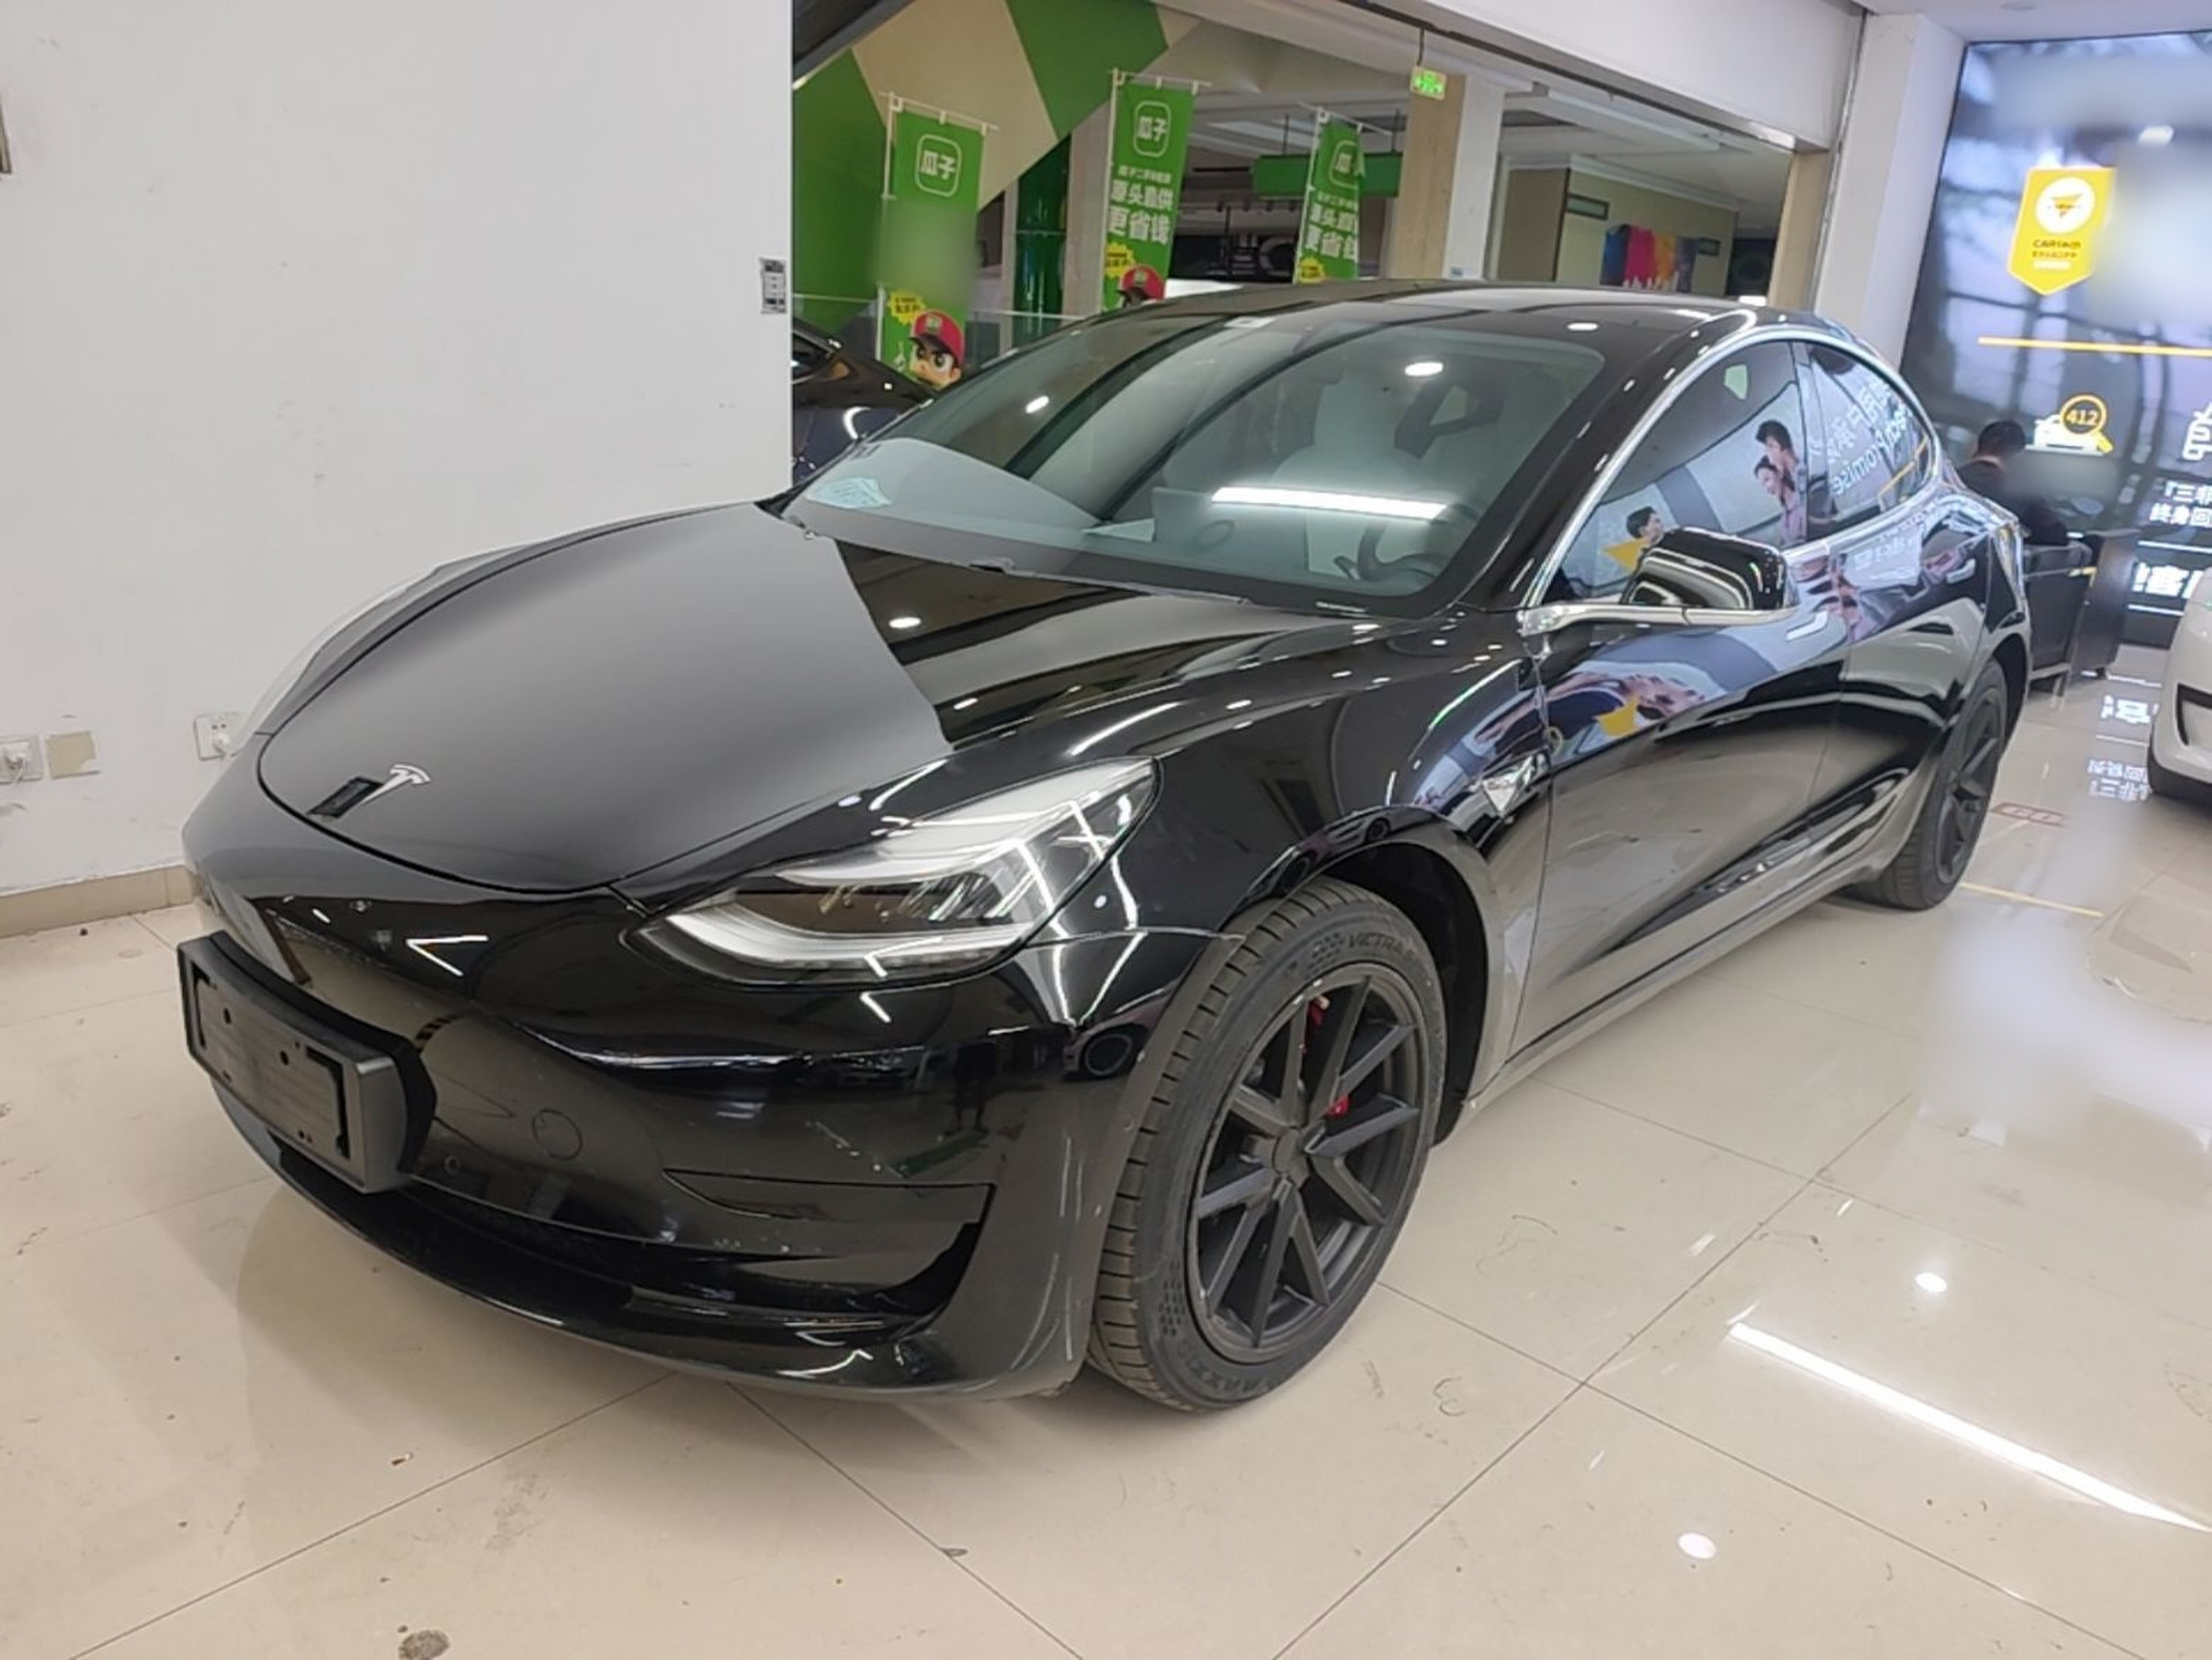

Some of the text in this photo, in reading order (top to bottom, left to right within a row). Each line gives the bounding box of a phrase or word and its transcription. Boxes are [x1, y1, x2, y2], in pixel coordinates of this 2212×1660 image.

[1137, 116, 1168, 141] 瓜子
[921, 150, 956, 180] 瓜子
[2066, 409, 2097, 425] 412
